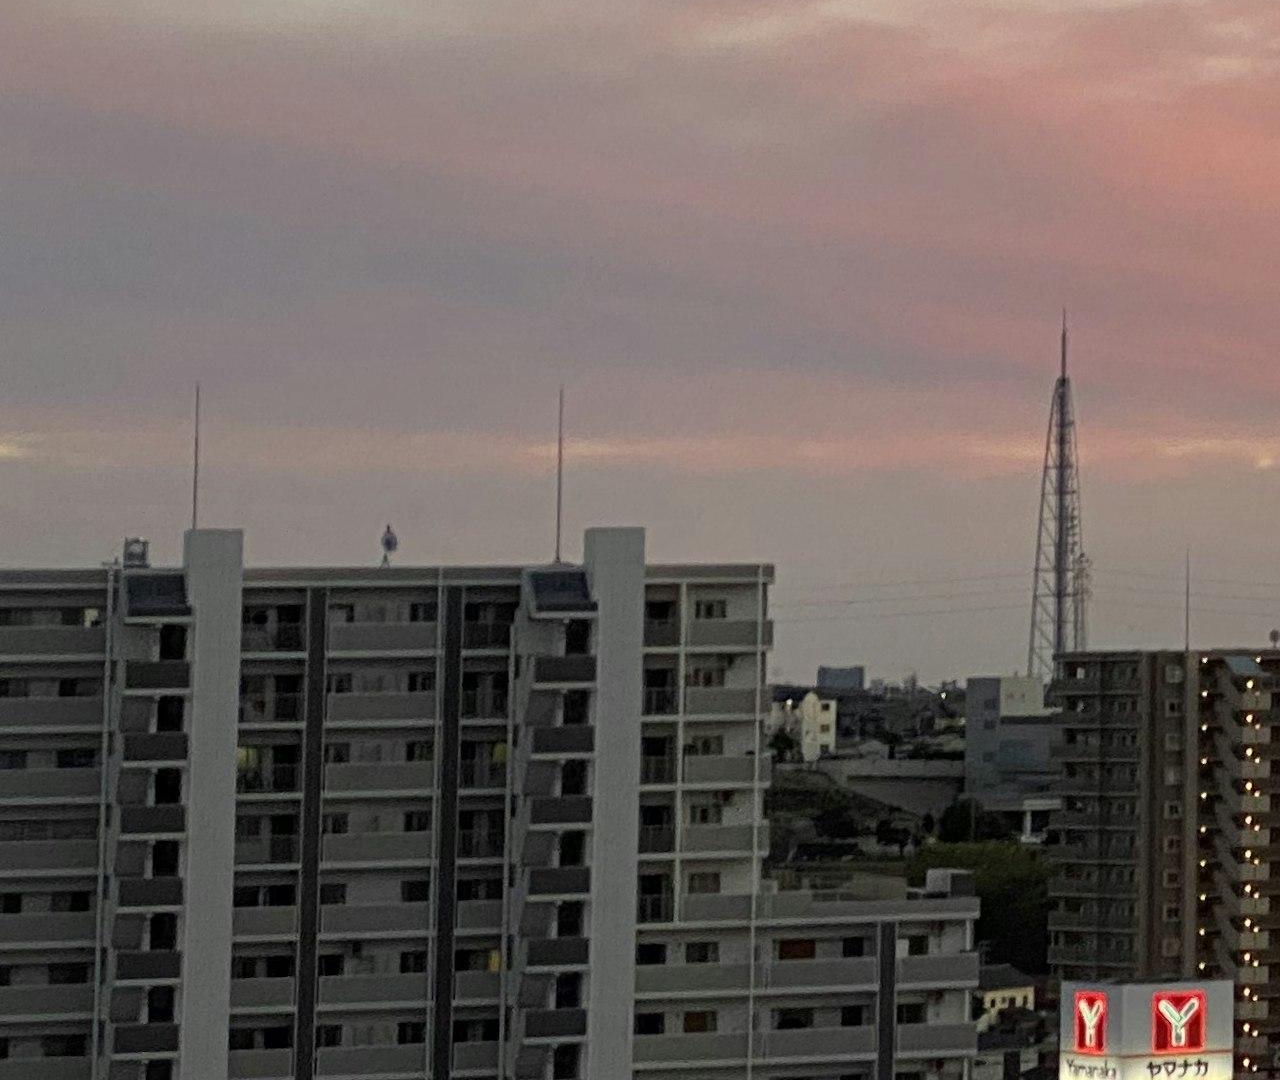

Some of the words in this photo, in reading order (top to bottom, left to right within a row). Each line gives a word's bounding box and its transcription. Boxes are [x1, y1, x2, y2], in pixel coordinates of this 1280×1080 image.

[1079, 998, 1104, 1047] Y
[1158, 997, 1199, 1047] Y
[1147, 1058, 1208, 1078] ヤマナカ
